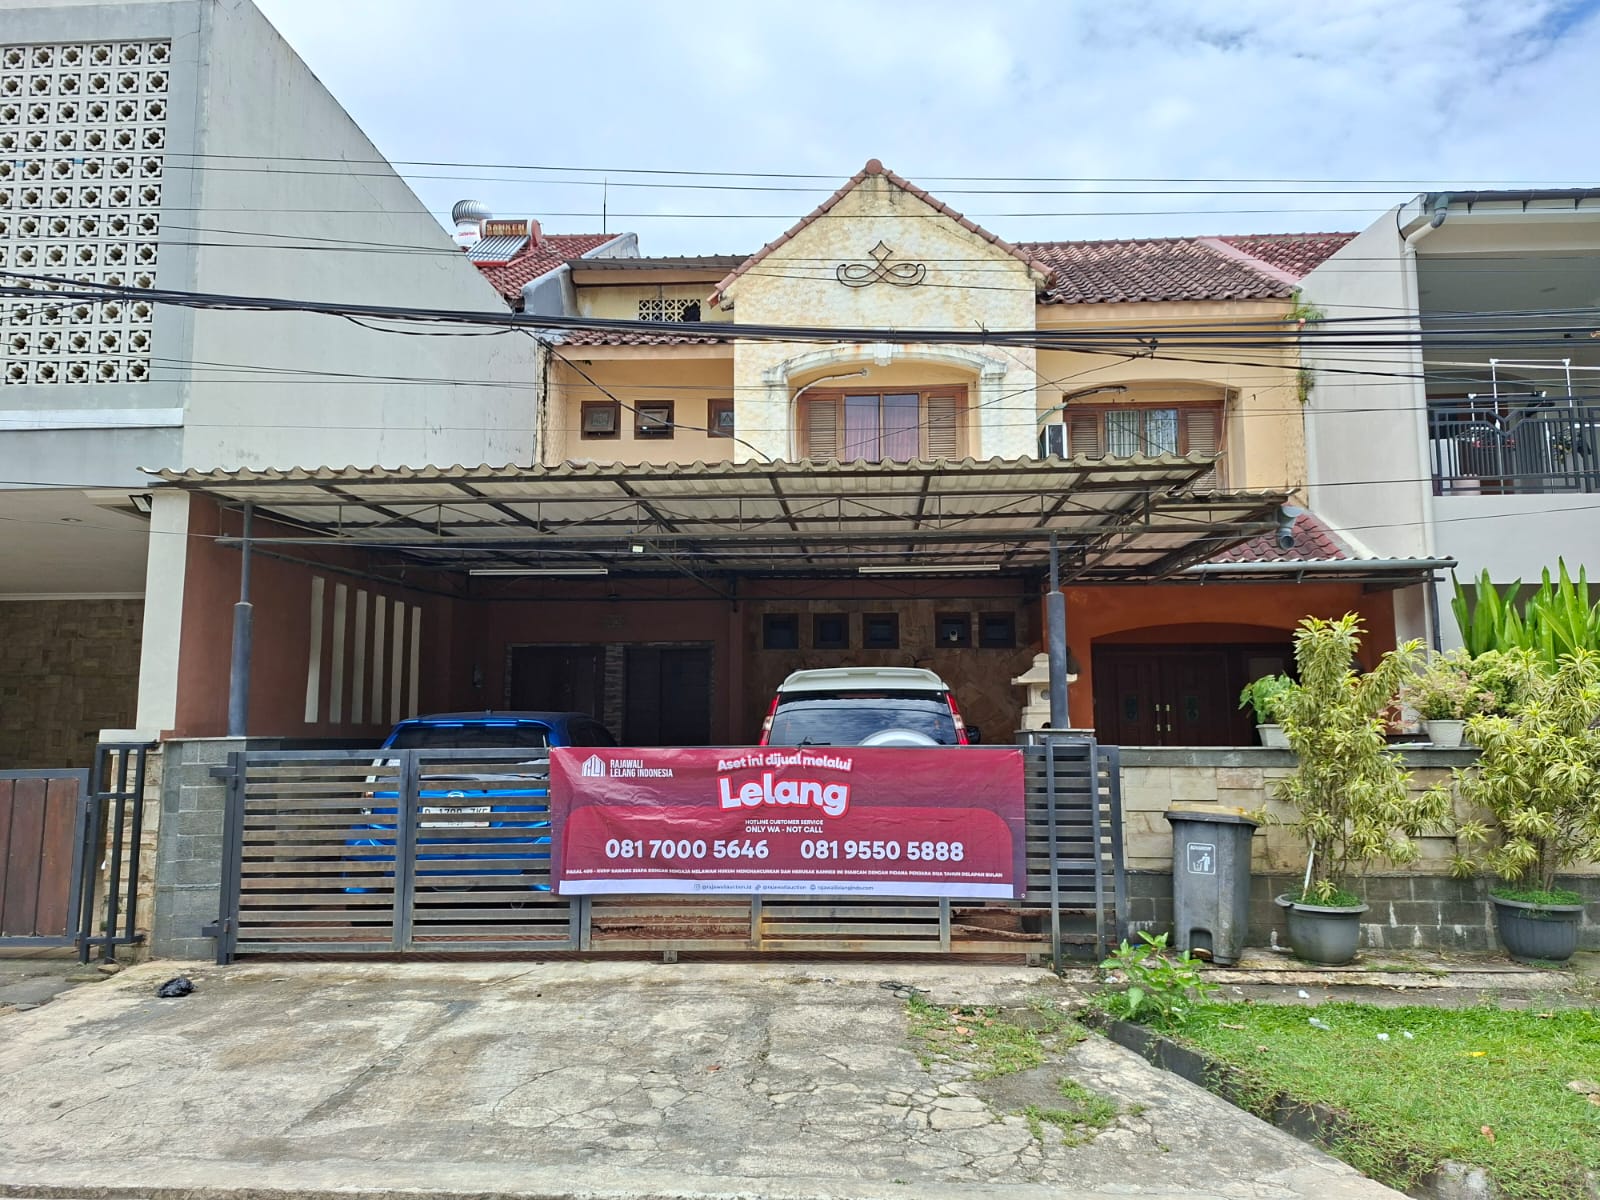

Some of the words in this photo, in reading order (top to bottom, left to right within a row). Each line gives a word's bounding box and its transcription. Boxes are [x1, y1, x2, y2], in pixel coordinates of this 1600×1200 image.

[610, 760, 643, 768] RAJAWALI
[718, 758, 747, 771] Aset
[748, 754, 763, 767] ini
[765, 753, 801, 768] dijual
[803, 756, 852, 771] melalui
[610, 769, 636, 777] LELANG
[637, 769, 673, 777] INDONESIA
[720, 773, 848, 815] Lelang
[804, 826, 823, 834] CALL
[605, 839, 643, 858] 081
[649, 840, 707, 859] 7000
[713, 840, 769, 859] 5646
[801, 840, 838, 859] 081
[844, 840, 900, 860] 9550
[907, 841, 964, 861] 5888
